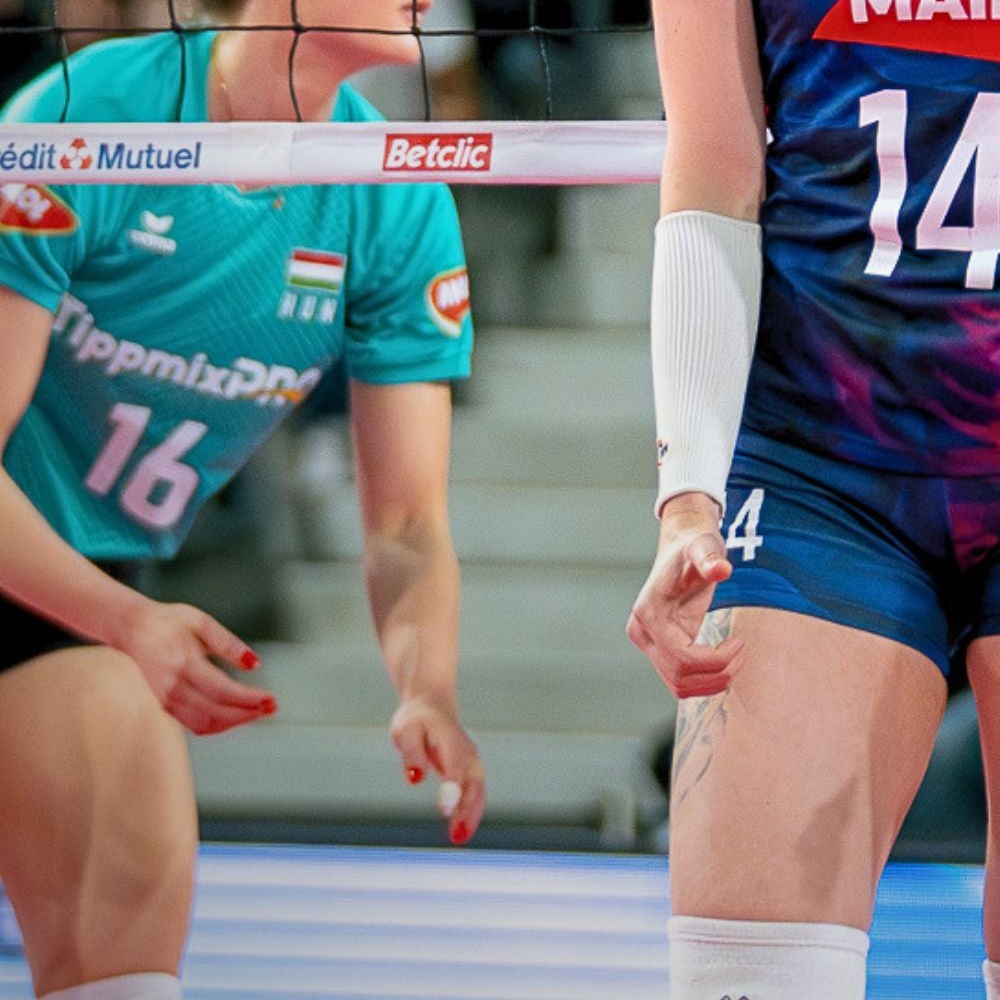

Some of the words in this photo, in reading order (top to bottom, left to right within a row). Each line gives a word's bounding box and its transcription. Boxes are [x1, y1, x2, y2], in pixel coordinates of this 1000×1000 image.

[0, 142, 57, 170] édit
[97, 141, 202, 170] Mutuel
[385, 136, 489, 169] Betclic
[84, 402, 208, 529] 16
[719, 488, 765, 562] 4
